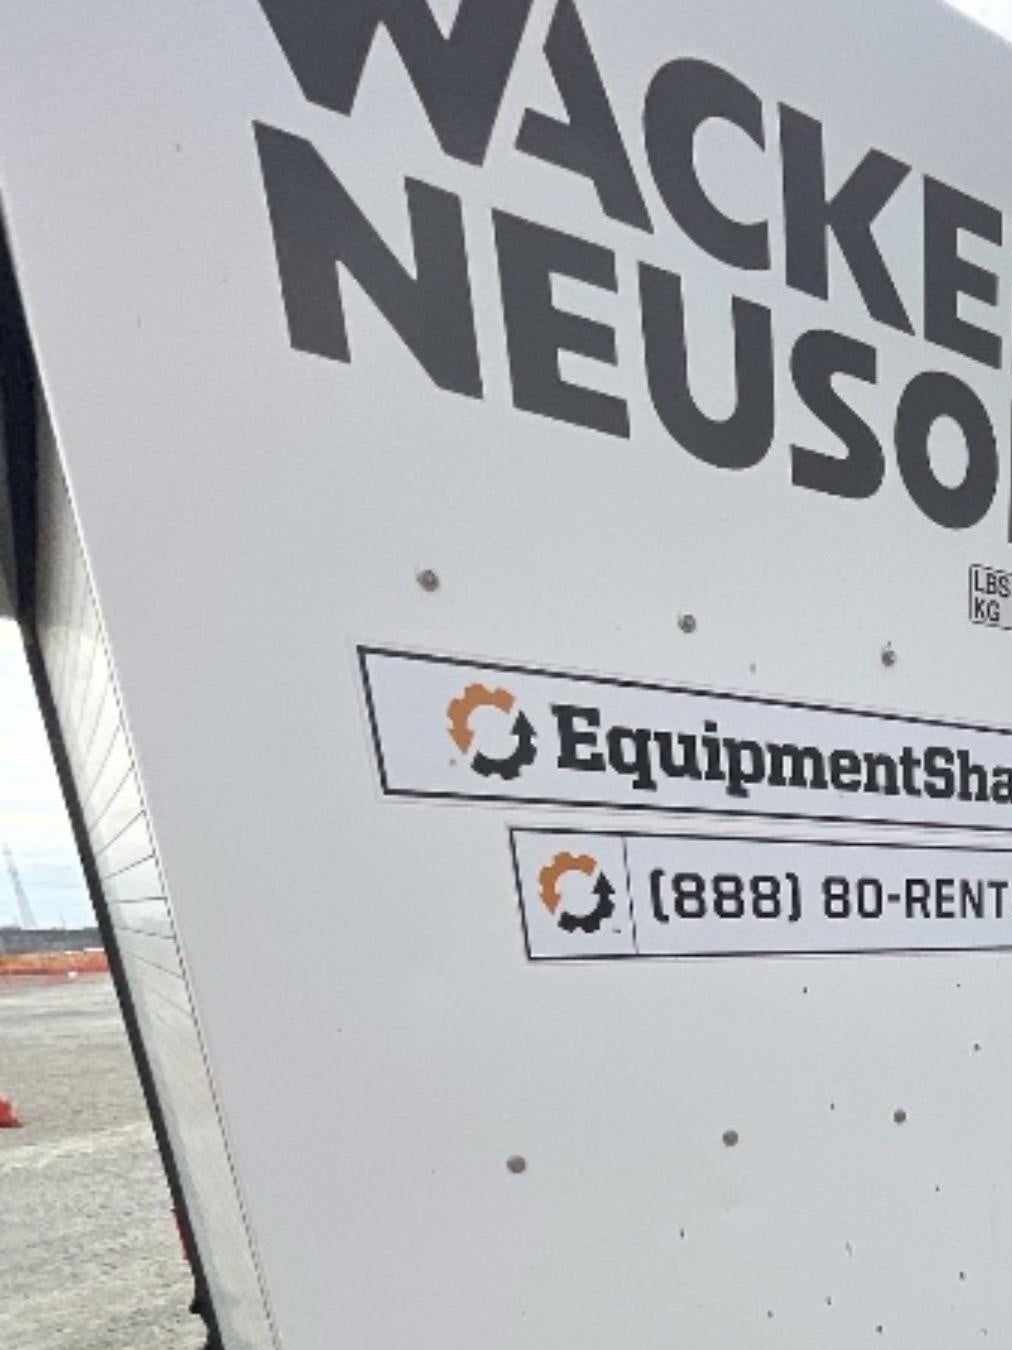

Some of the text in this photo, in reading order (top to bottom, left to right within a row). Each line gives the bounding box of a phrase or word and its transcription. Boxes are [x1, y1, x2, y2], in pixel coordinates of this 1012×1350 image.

[974, 569, 1011, 598] LBS
[974, 597, 1000, 622] KG
[648, 867, 801, 924] (888)
